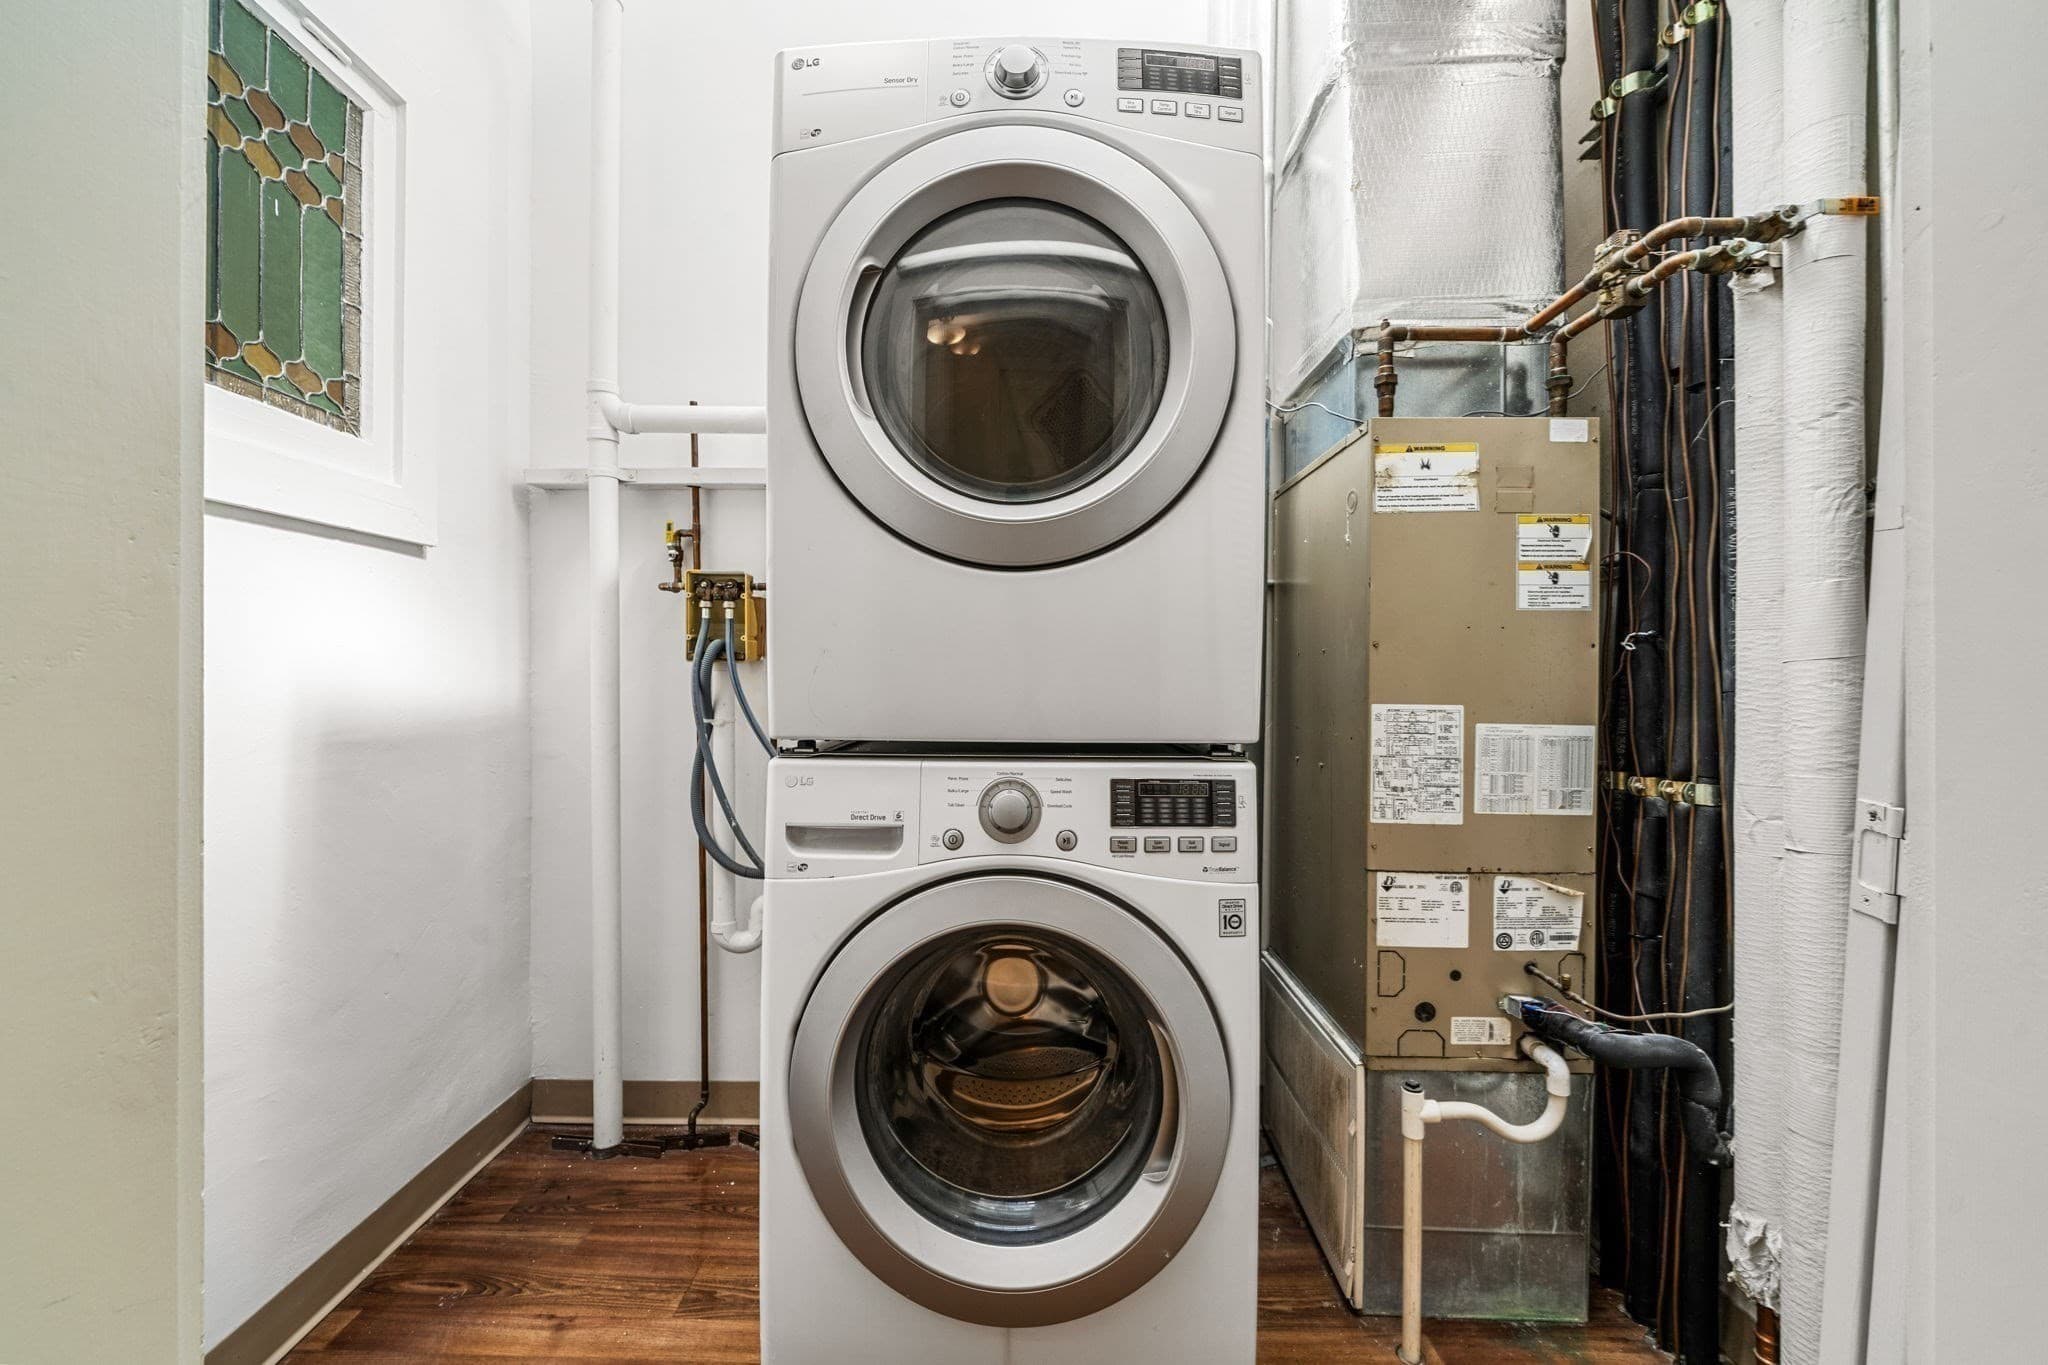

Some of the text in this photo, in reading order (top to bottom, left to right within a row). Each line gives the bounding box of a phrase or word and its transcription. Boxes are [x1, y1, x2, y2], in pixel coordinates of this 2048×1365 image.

[806, 58, 820, 67] LG
[906, 76, 919, 84] Dry
[799, 777, 814, 786] LG
[850, 813, 886, 821] Direct Drive
[1222, 914, 1242, 930] 10
